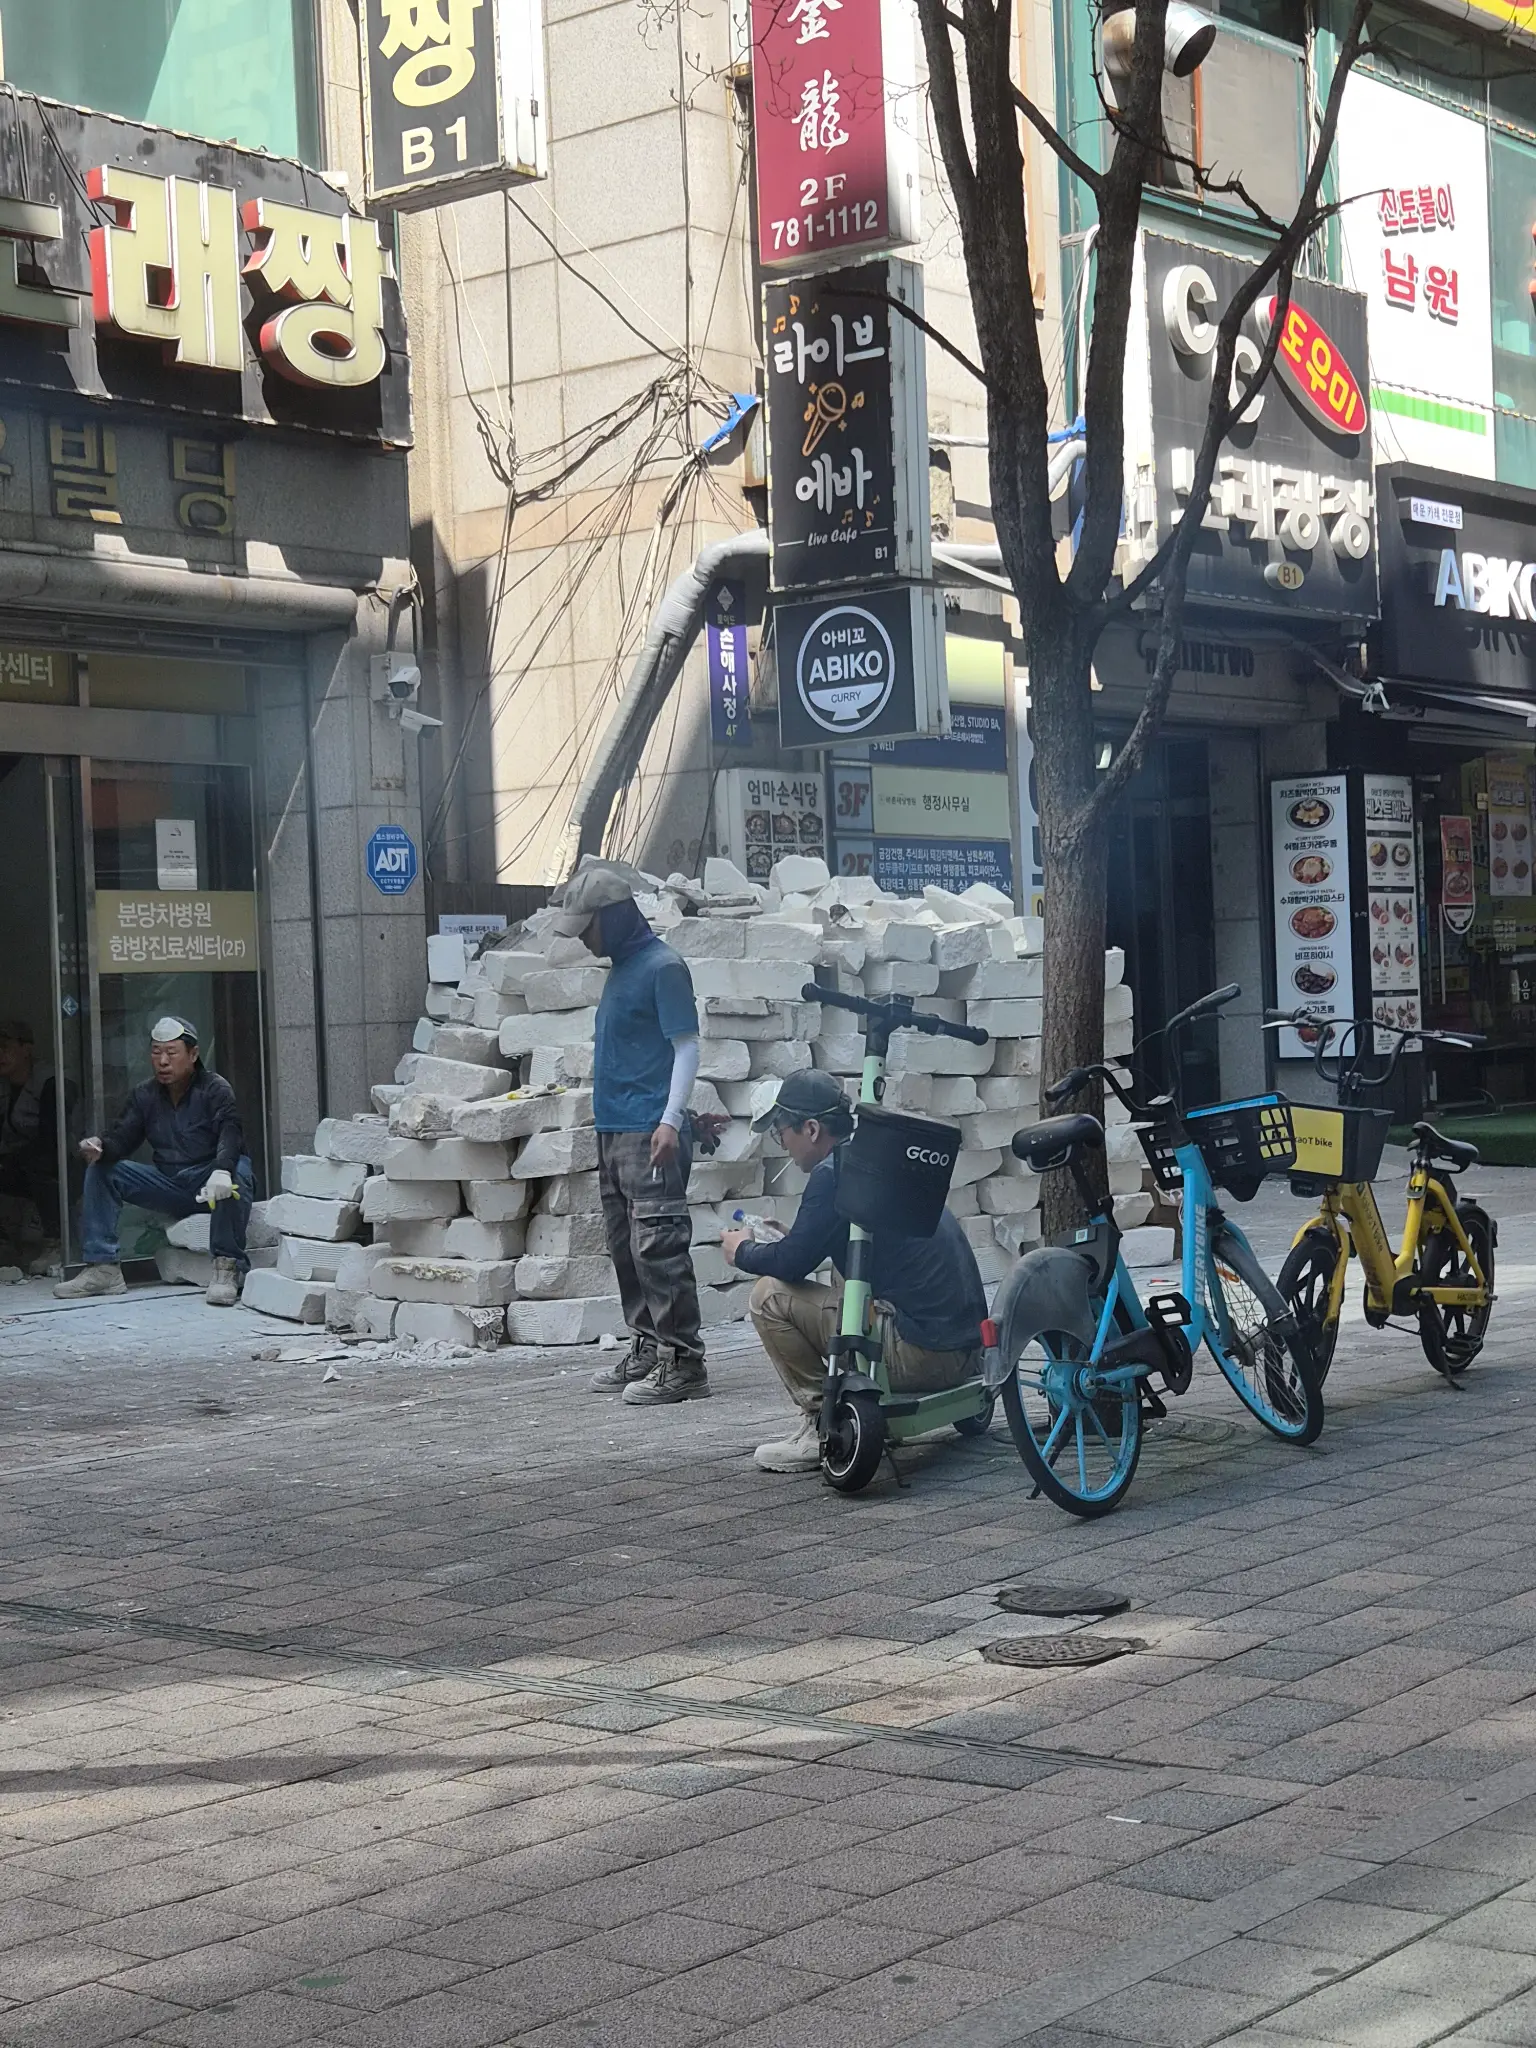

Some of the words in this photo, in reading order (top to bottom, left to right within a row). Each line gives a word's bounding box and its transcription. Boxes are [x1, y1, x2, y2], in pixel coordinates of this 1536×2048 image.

[401, 116, 469, 176] B1
[1378, 183, 1456, 236] 신토불이
[770, 199, 879, 250] 781-1112
[772, 313, 886, 385] 라이브
[1281, 310, 1357, 425] 도우미
[0, 418, 237, 535] 빌딩
[795, 446, 873, 515] 에바
[807, 529, 829, 547] Live
[830, 526, 858, 546] Cafe
[874, 545, 889, 560] B1
[1282, 566, 1298, 585] B1
[821, 626, 867, 649] 아비꼬
[719, 627, 738, 720] 손해사정
[808, 649, 883, 685] ABIKO
[830, 690, 862, 704] CURRY
[967, 716, 990, 730] STUDIO
[747, 779, 818, 808] 엄마손식당
[837, 780, 870, 818] 3F
[922, 793, 970, 812] 행정사무실
[375, 847, 410, 872] ADT
[117, 901, 212, 929] 분당차병원
[109, 934, 246, 962] 한방진료센터(2F)
[905, 1144, 950, 1168] GCOO
[1314, 1137, 1333, 1148] bike
[1194, 1203, 1207, 1307] EVERYBIKE
